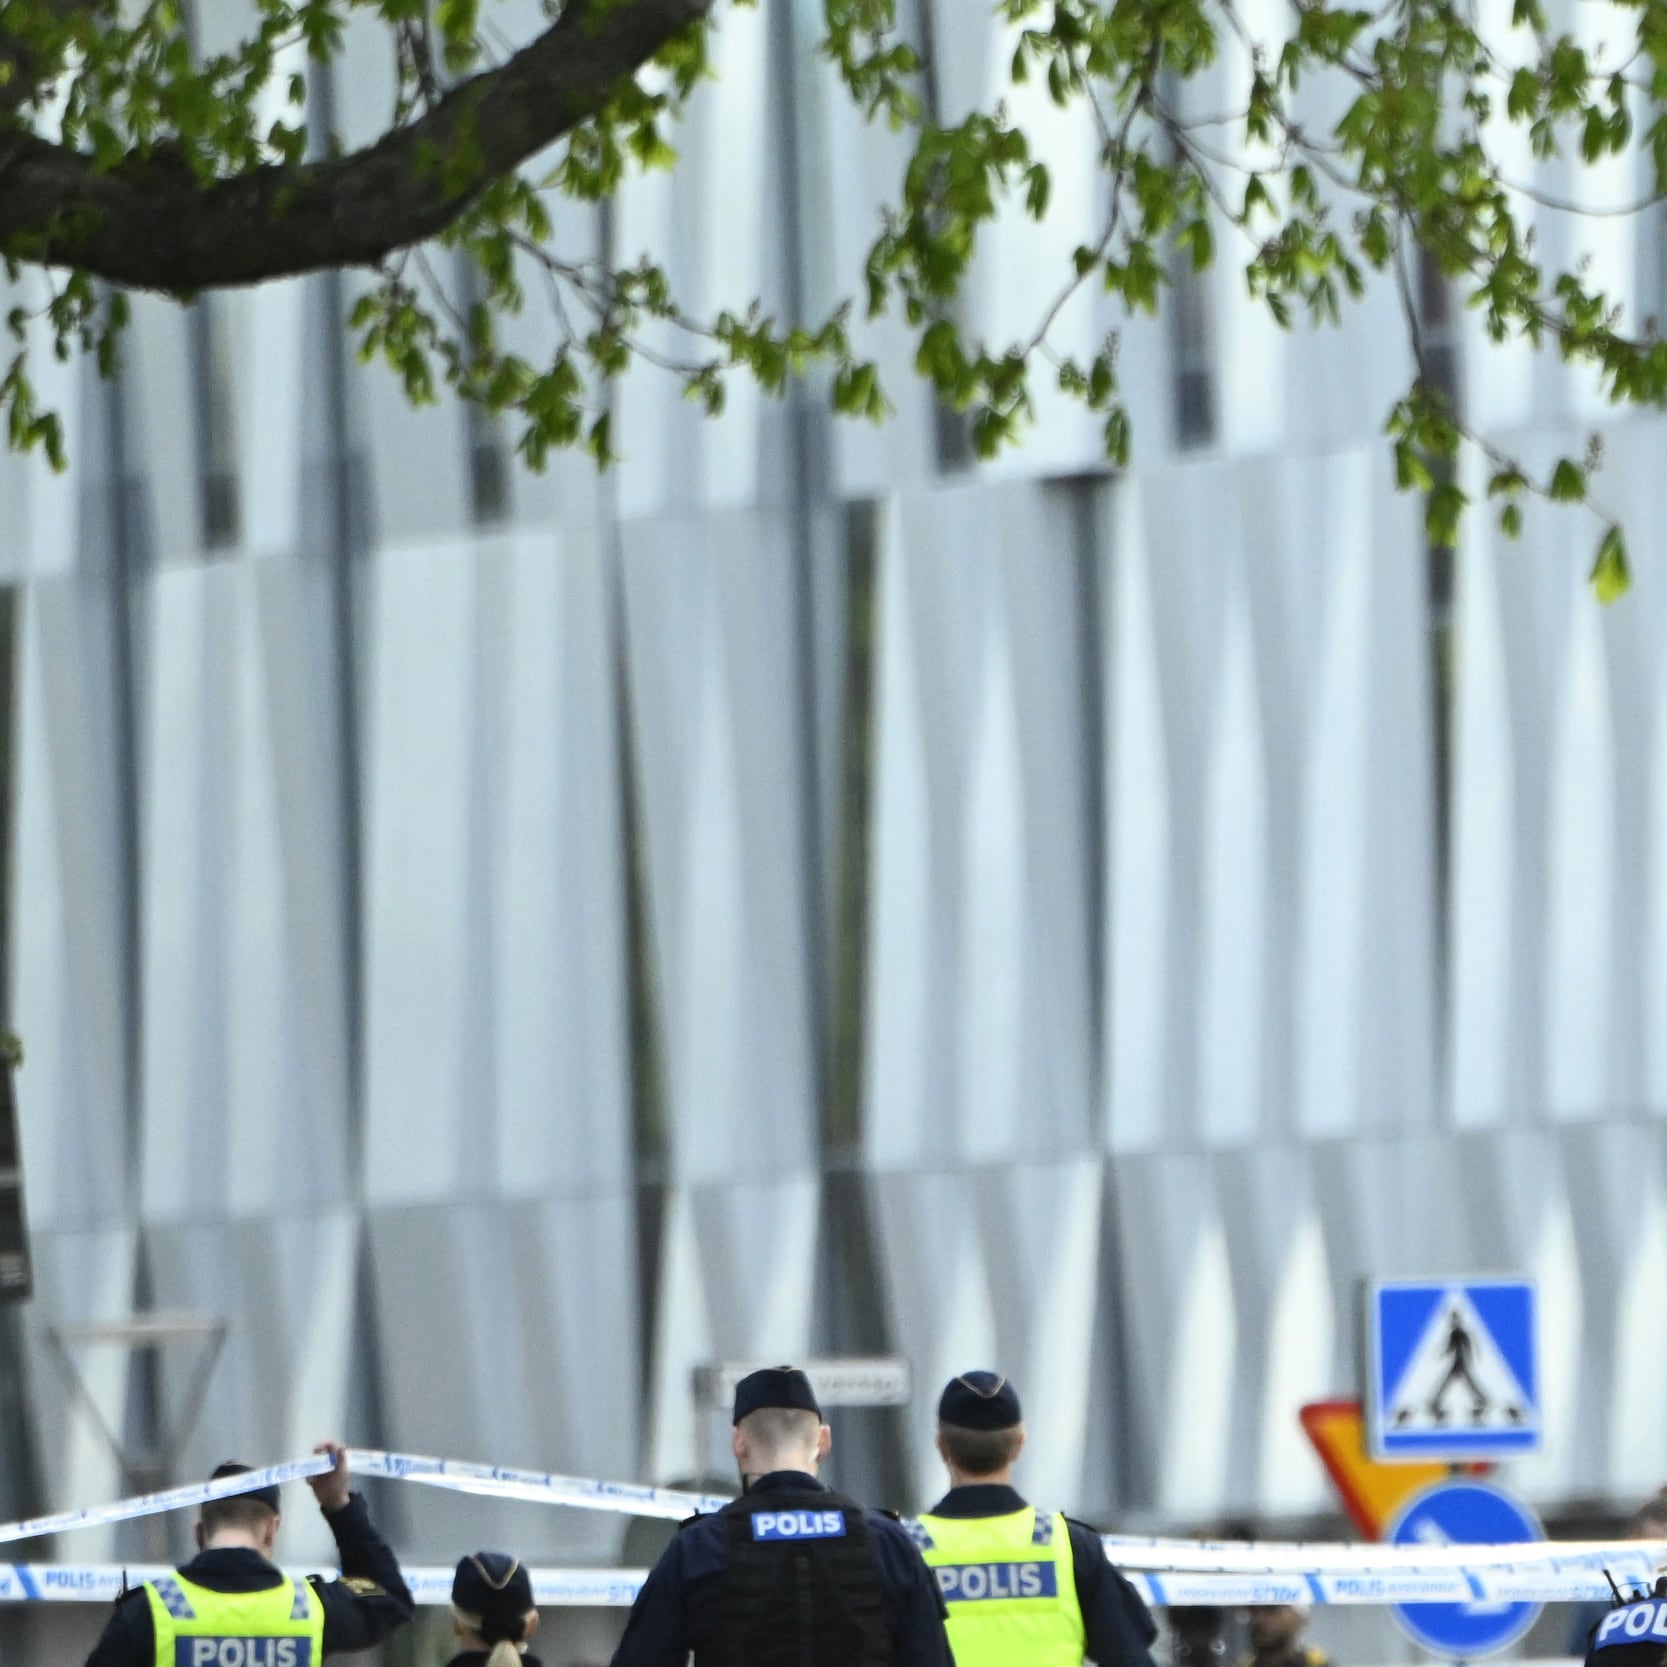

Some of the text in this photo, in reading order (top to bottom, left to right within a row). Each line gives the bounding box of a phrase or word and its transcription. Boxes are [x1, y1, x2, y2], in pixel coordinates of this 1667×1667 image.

[756, 1513, 841, 1536] POLIS
[46, 1573, 95, 1589] POLIS
[935, 1563, 1042, 1599] POLIS
[1334, 1579, 1385, 1596] POLIS
